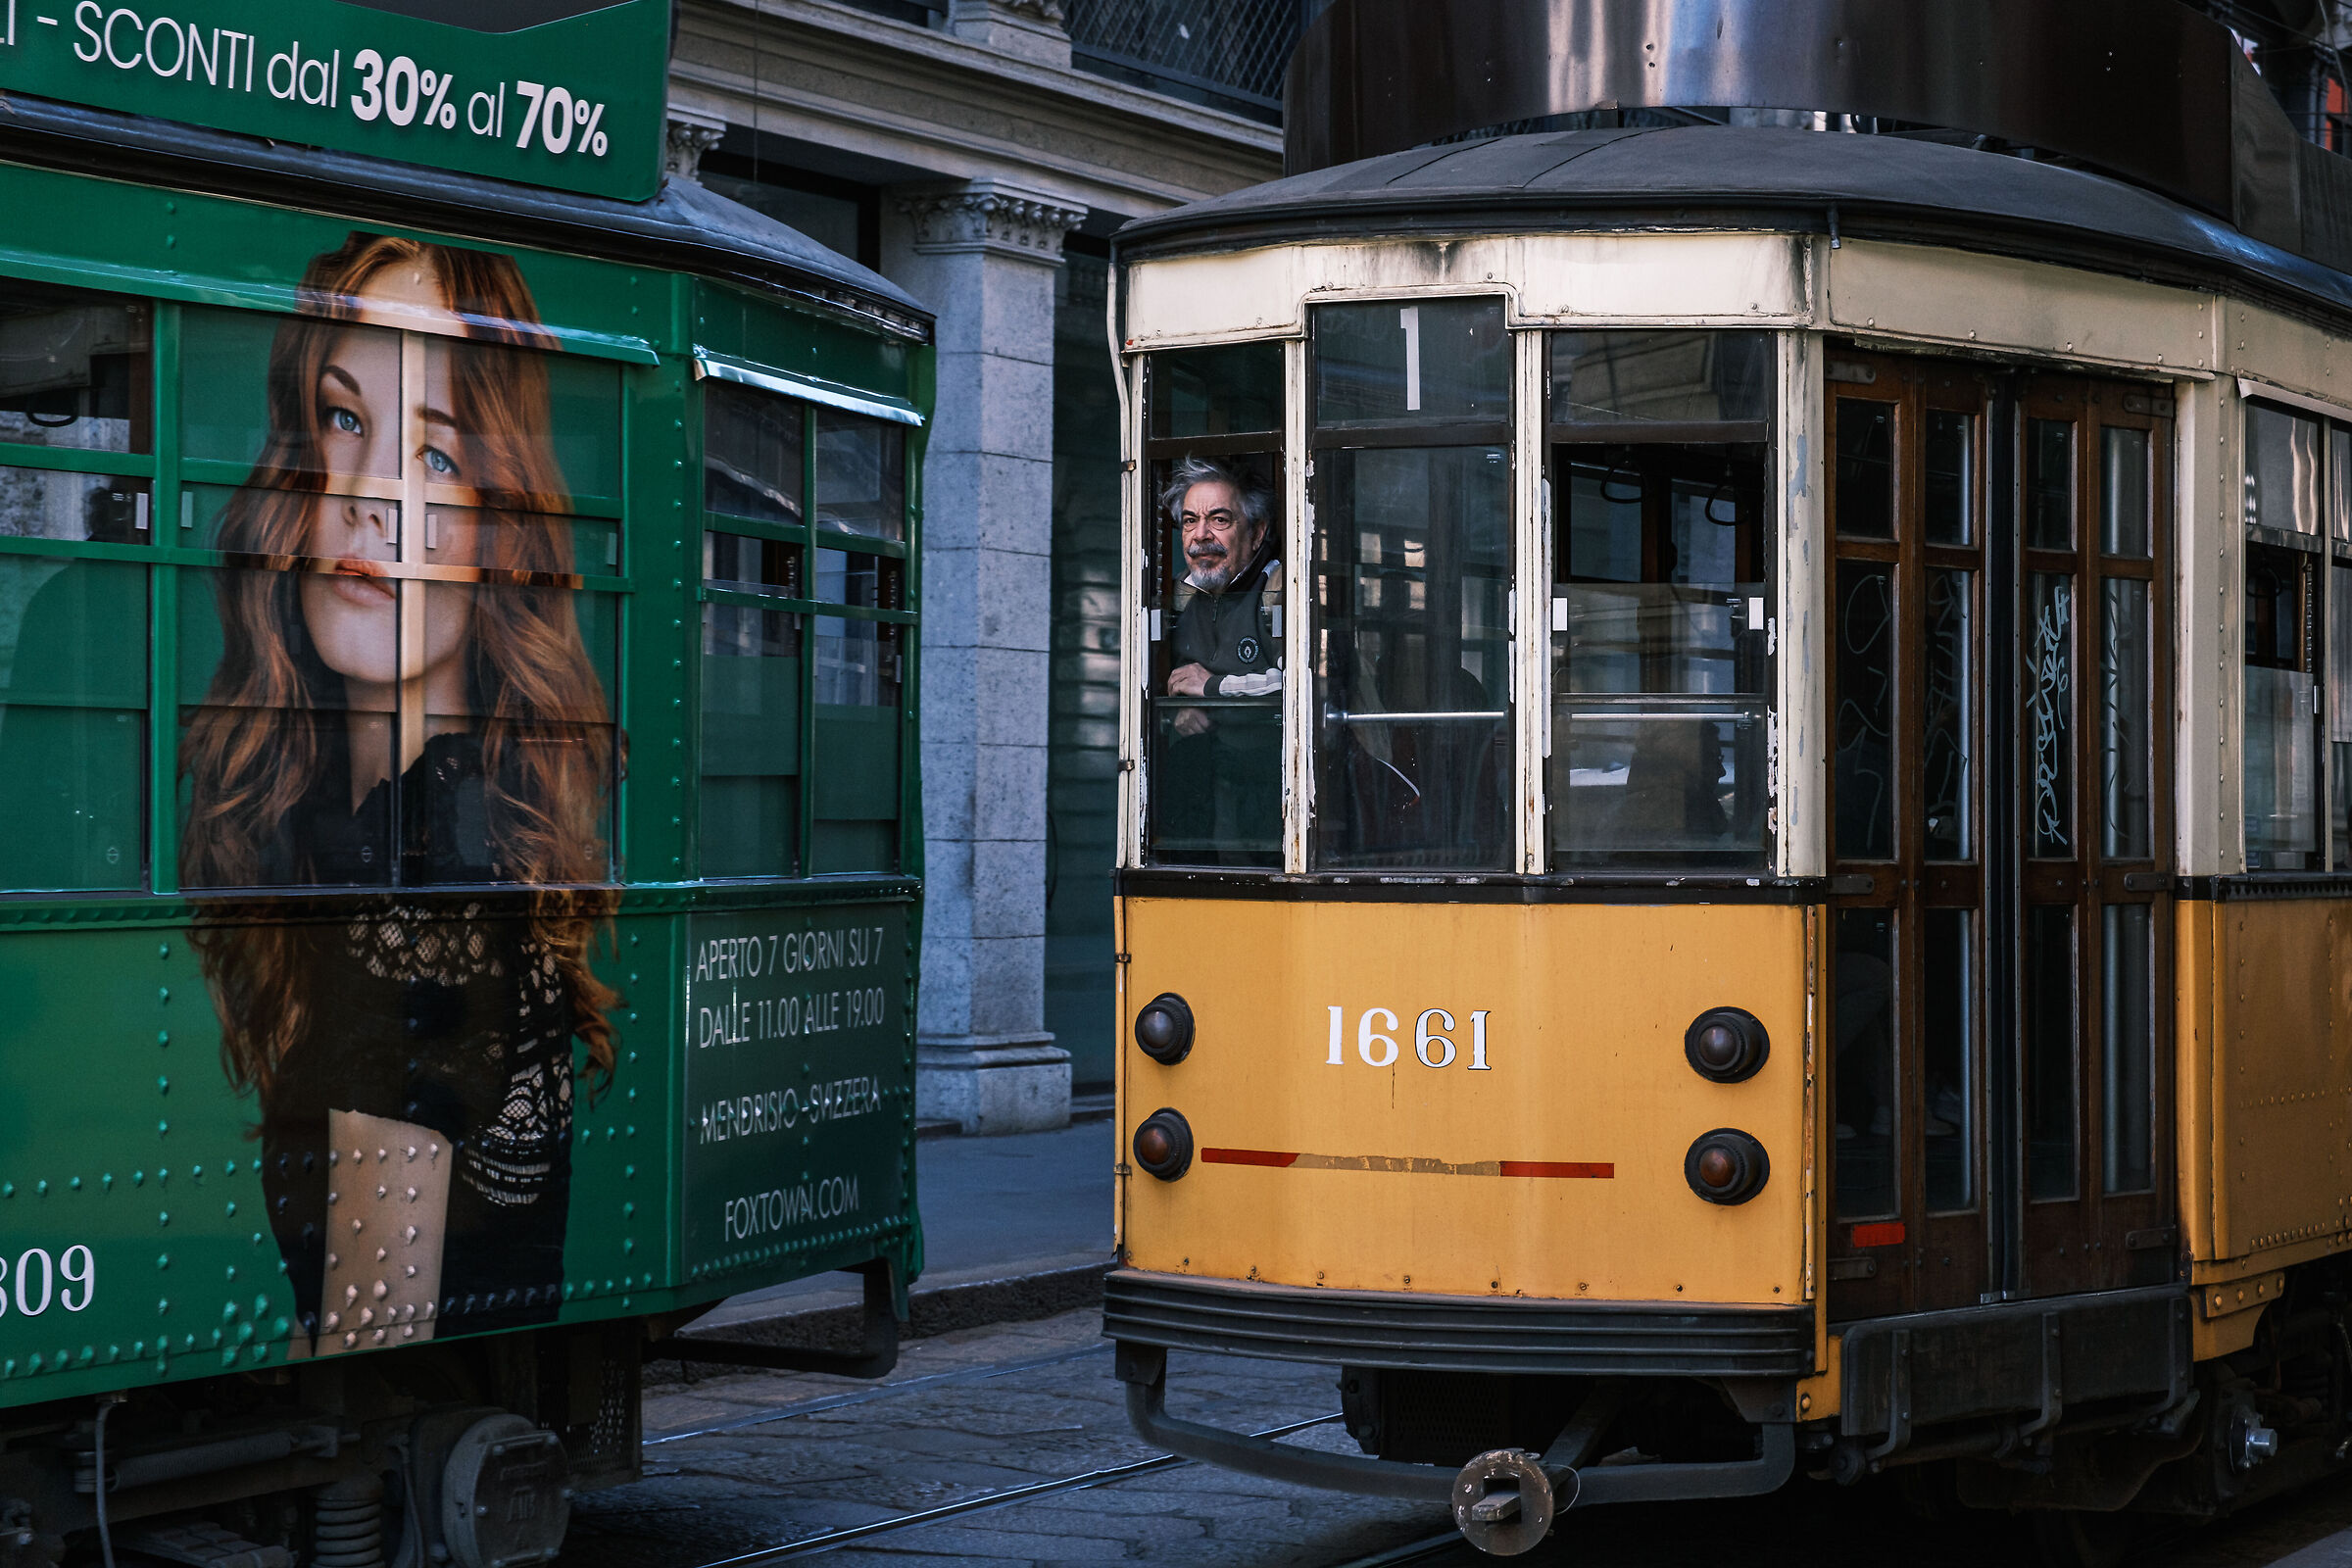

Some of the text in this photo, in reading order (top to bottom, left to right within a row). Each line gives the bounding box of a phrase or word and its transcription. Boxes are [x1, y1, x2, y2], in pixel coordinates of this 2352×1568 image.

[73, 0, 255, 92] SCONTI
[267, 41, 340, 108] dal
[351, 49, 457, 129] 30%
[467, 81, 505, 137] al
[515, 80, 608, 157] 70%
[1399, 306, 1421, 411] 1
[695, 927, 883, 982] APERTO 7 GIORNI SU 7
[700, 987, 884, 1049] DALLE 11.00 ALLE 19.00
[1325, 1005, 1492, 1070] 1661
[700, 1088, 799, 1145] MENDRISIO
[809, 1074, 881, 1124] SVIZZERA
[725, 1173, 858, 1243] FOXTOWN.COM
[0, 1244, 95, 1318] 09
